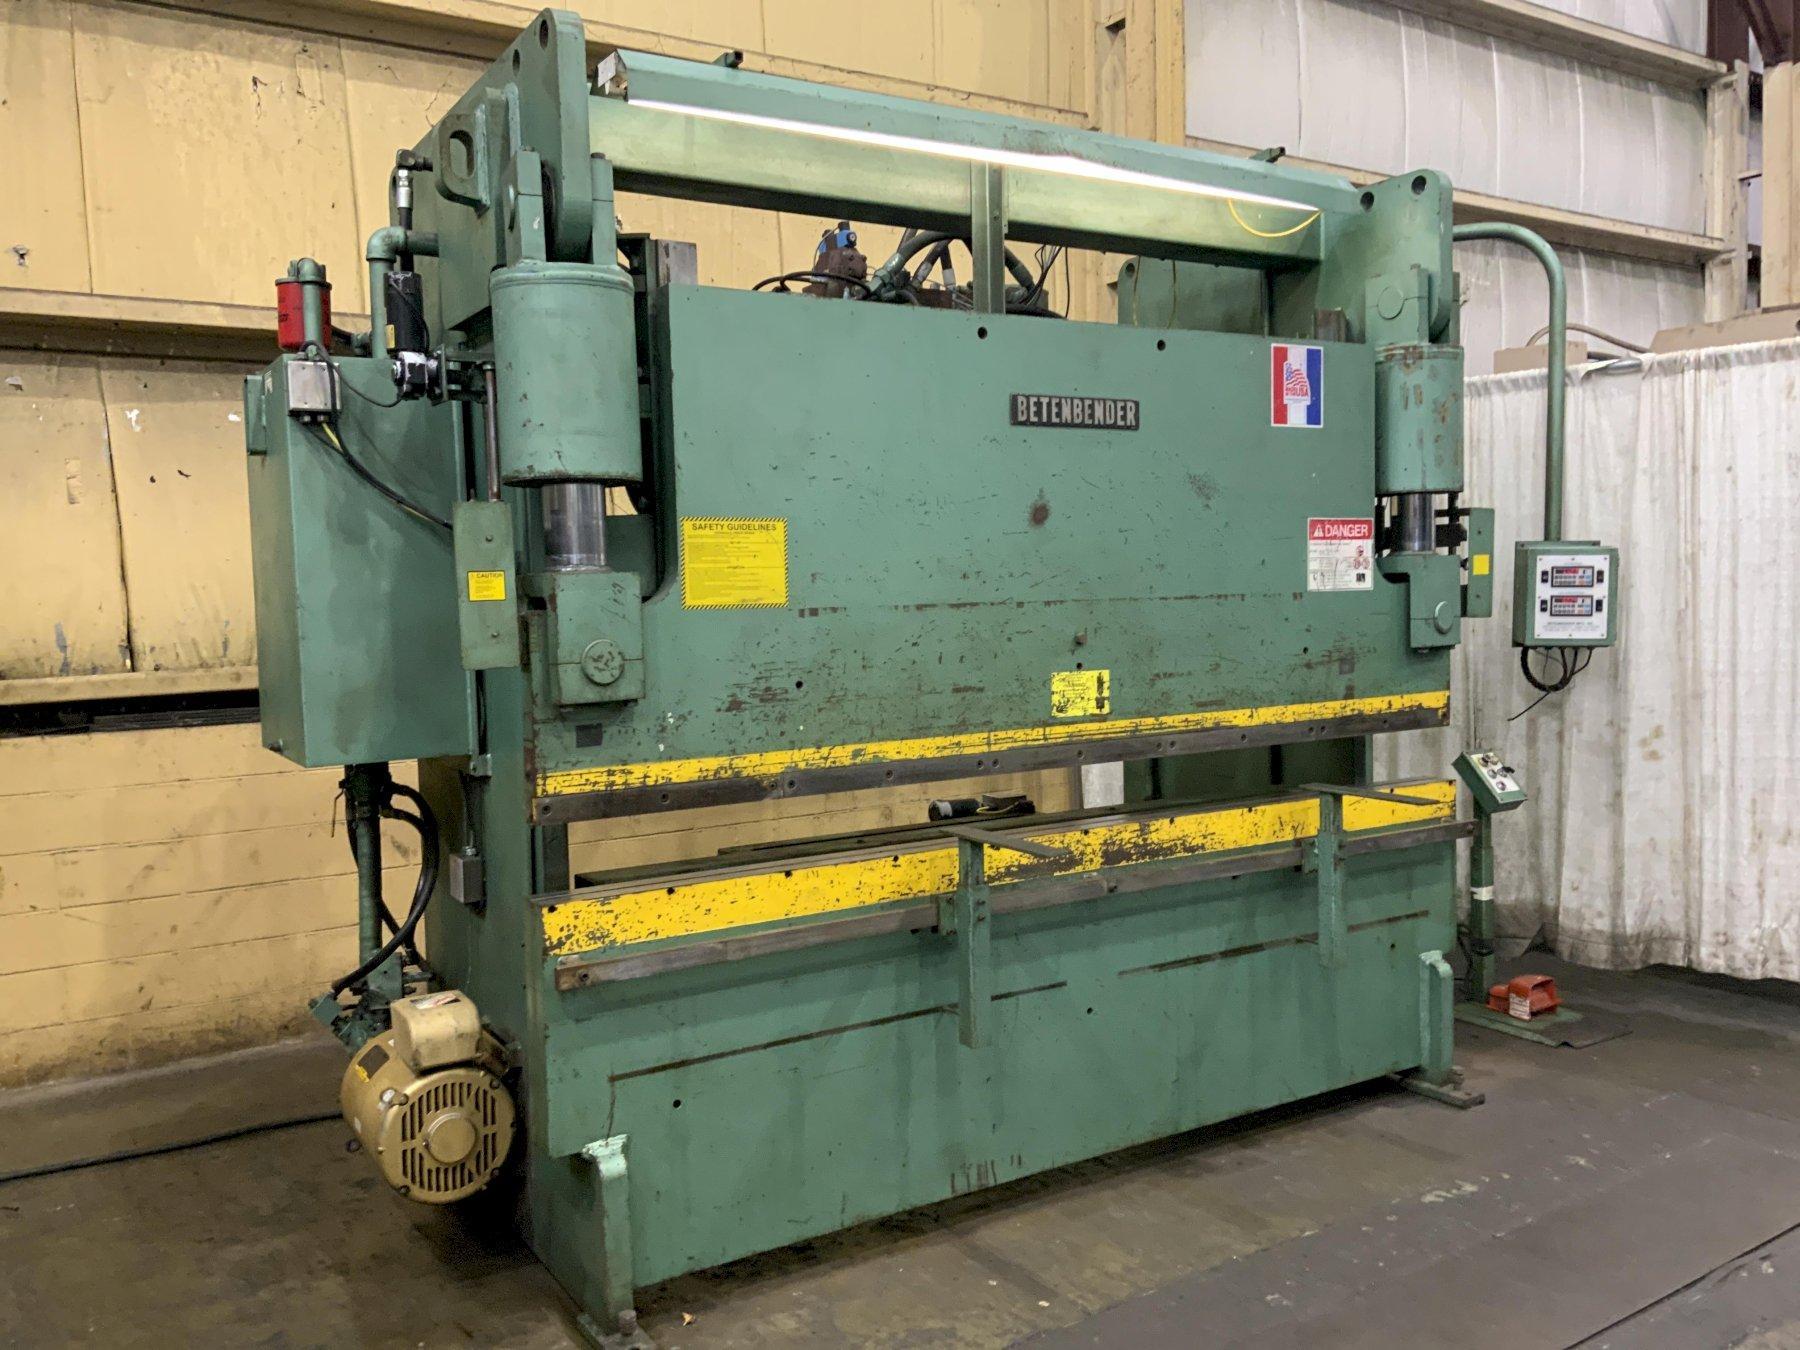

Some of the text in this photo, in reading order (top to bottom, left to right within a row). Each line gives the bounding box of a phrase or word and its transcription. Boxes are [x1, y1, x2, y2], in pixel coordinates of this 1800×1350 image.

[1017, 395, 1136, 427] BETENBENDER
[692, 523, 777, 531] SAFETY GUIDELINES
[1325, 524, 1369, 537] DANGER
